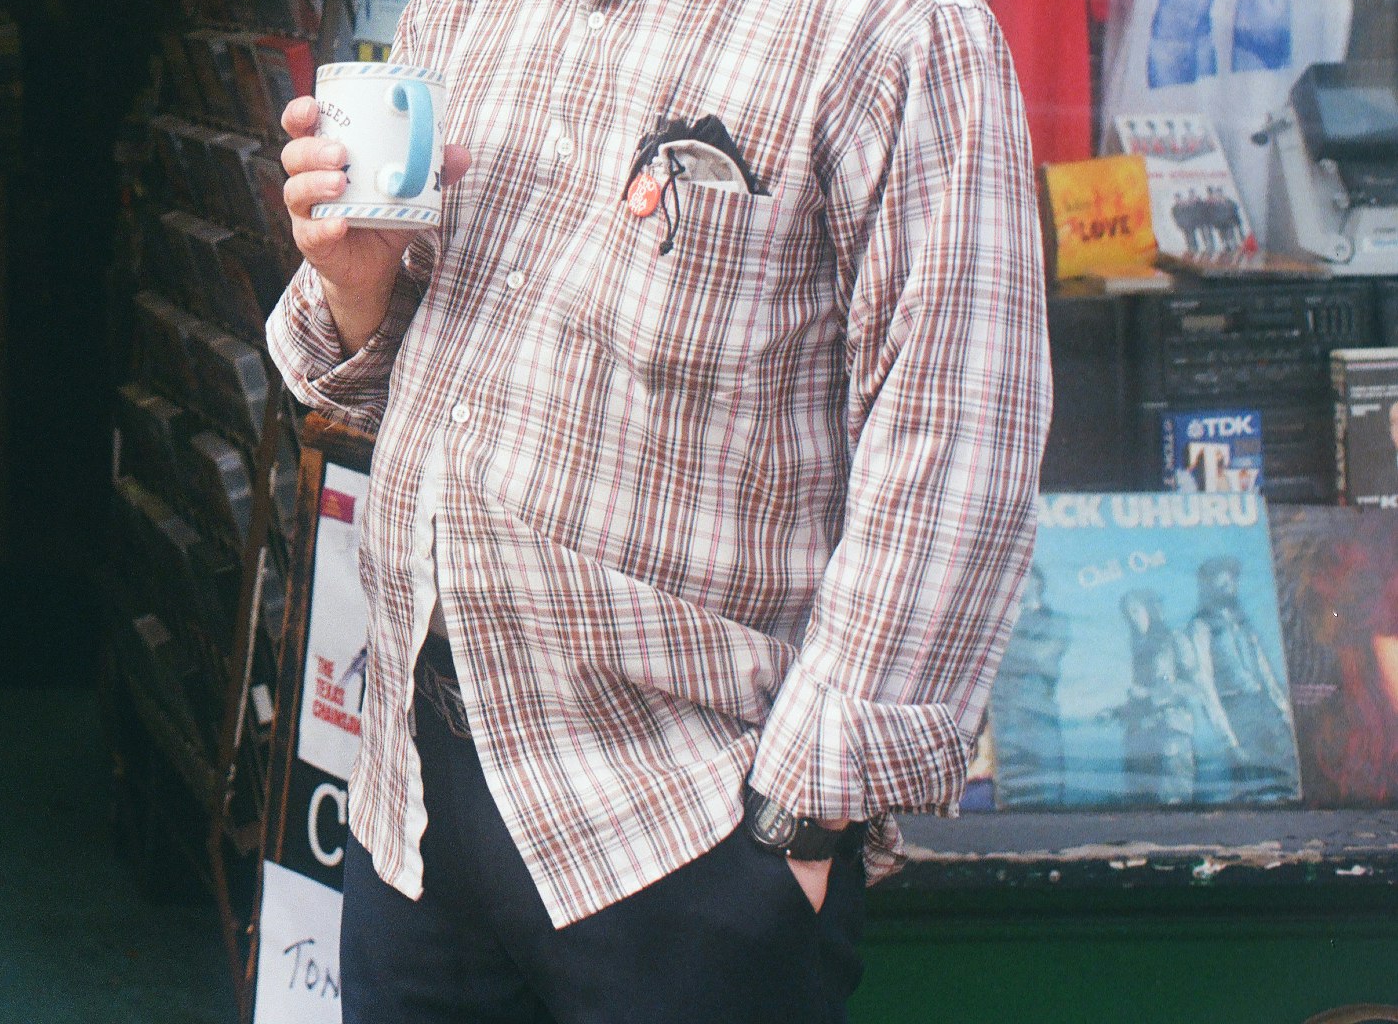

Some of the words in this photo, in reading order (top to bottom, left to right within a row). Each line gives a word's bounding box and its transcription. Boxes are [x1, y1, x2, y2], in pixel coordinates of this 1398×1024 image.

[1201, 414, 1254, 437] TDK
[1112, 493, 1259, 527] UHURU
[317, 653, 336, 680] THE
[315, 677, 346, 706] TEXAS
